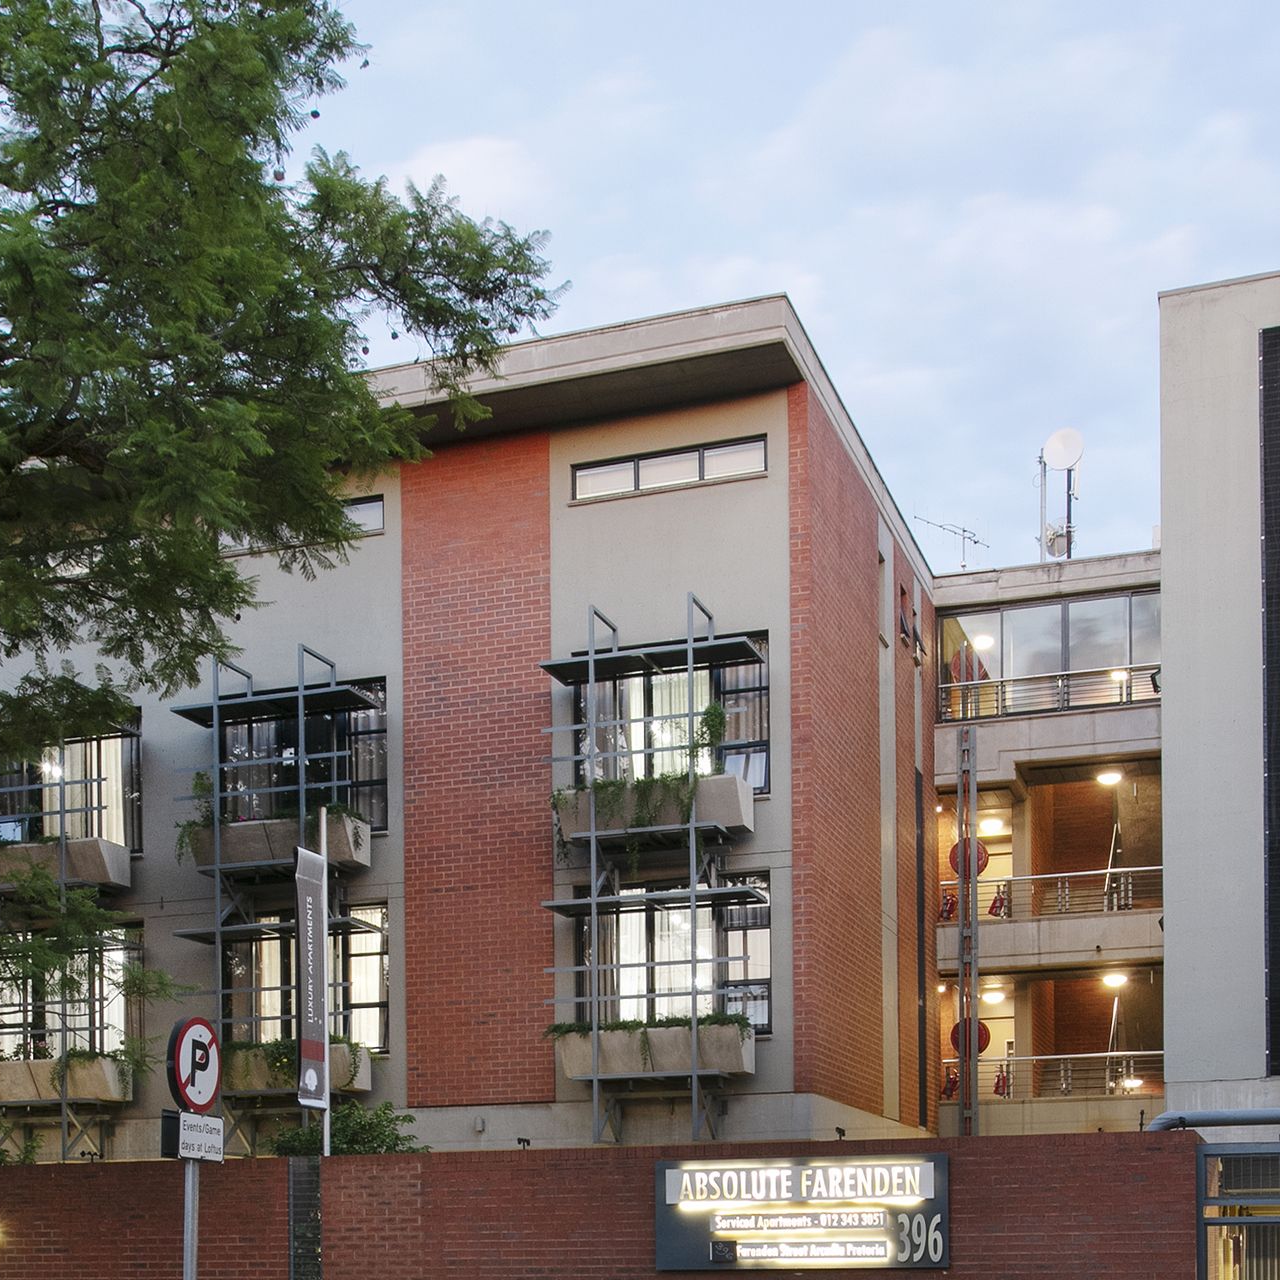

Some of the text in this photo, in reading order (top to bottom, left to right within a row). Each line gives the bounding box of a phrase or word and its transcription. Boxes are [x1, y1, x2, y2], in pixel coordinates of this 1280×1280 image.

[191, 1038, 210, 1087] P
[182, 1119, 221, 1136] Events/Game
[181, 1139, 222, 1155] days at Loftus
[680, 1166, 920, 1201] ABSOLUTE FARENDEN
[715, 1215, 755, 1229] Serviced
[757, 1215, 812, 1231] Apartments
[820, 1213, 838, 1227] 012
[840, 1213, 859, 1226] 343
[897, 1213, 943, 1263] 396
